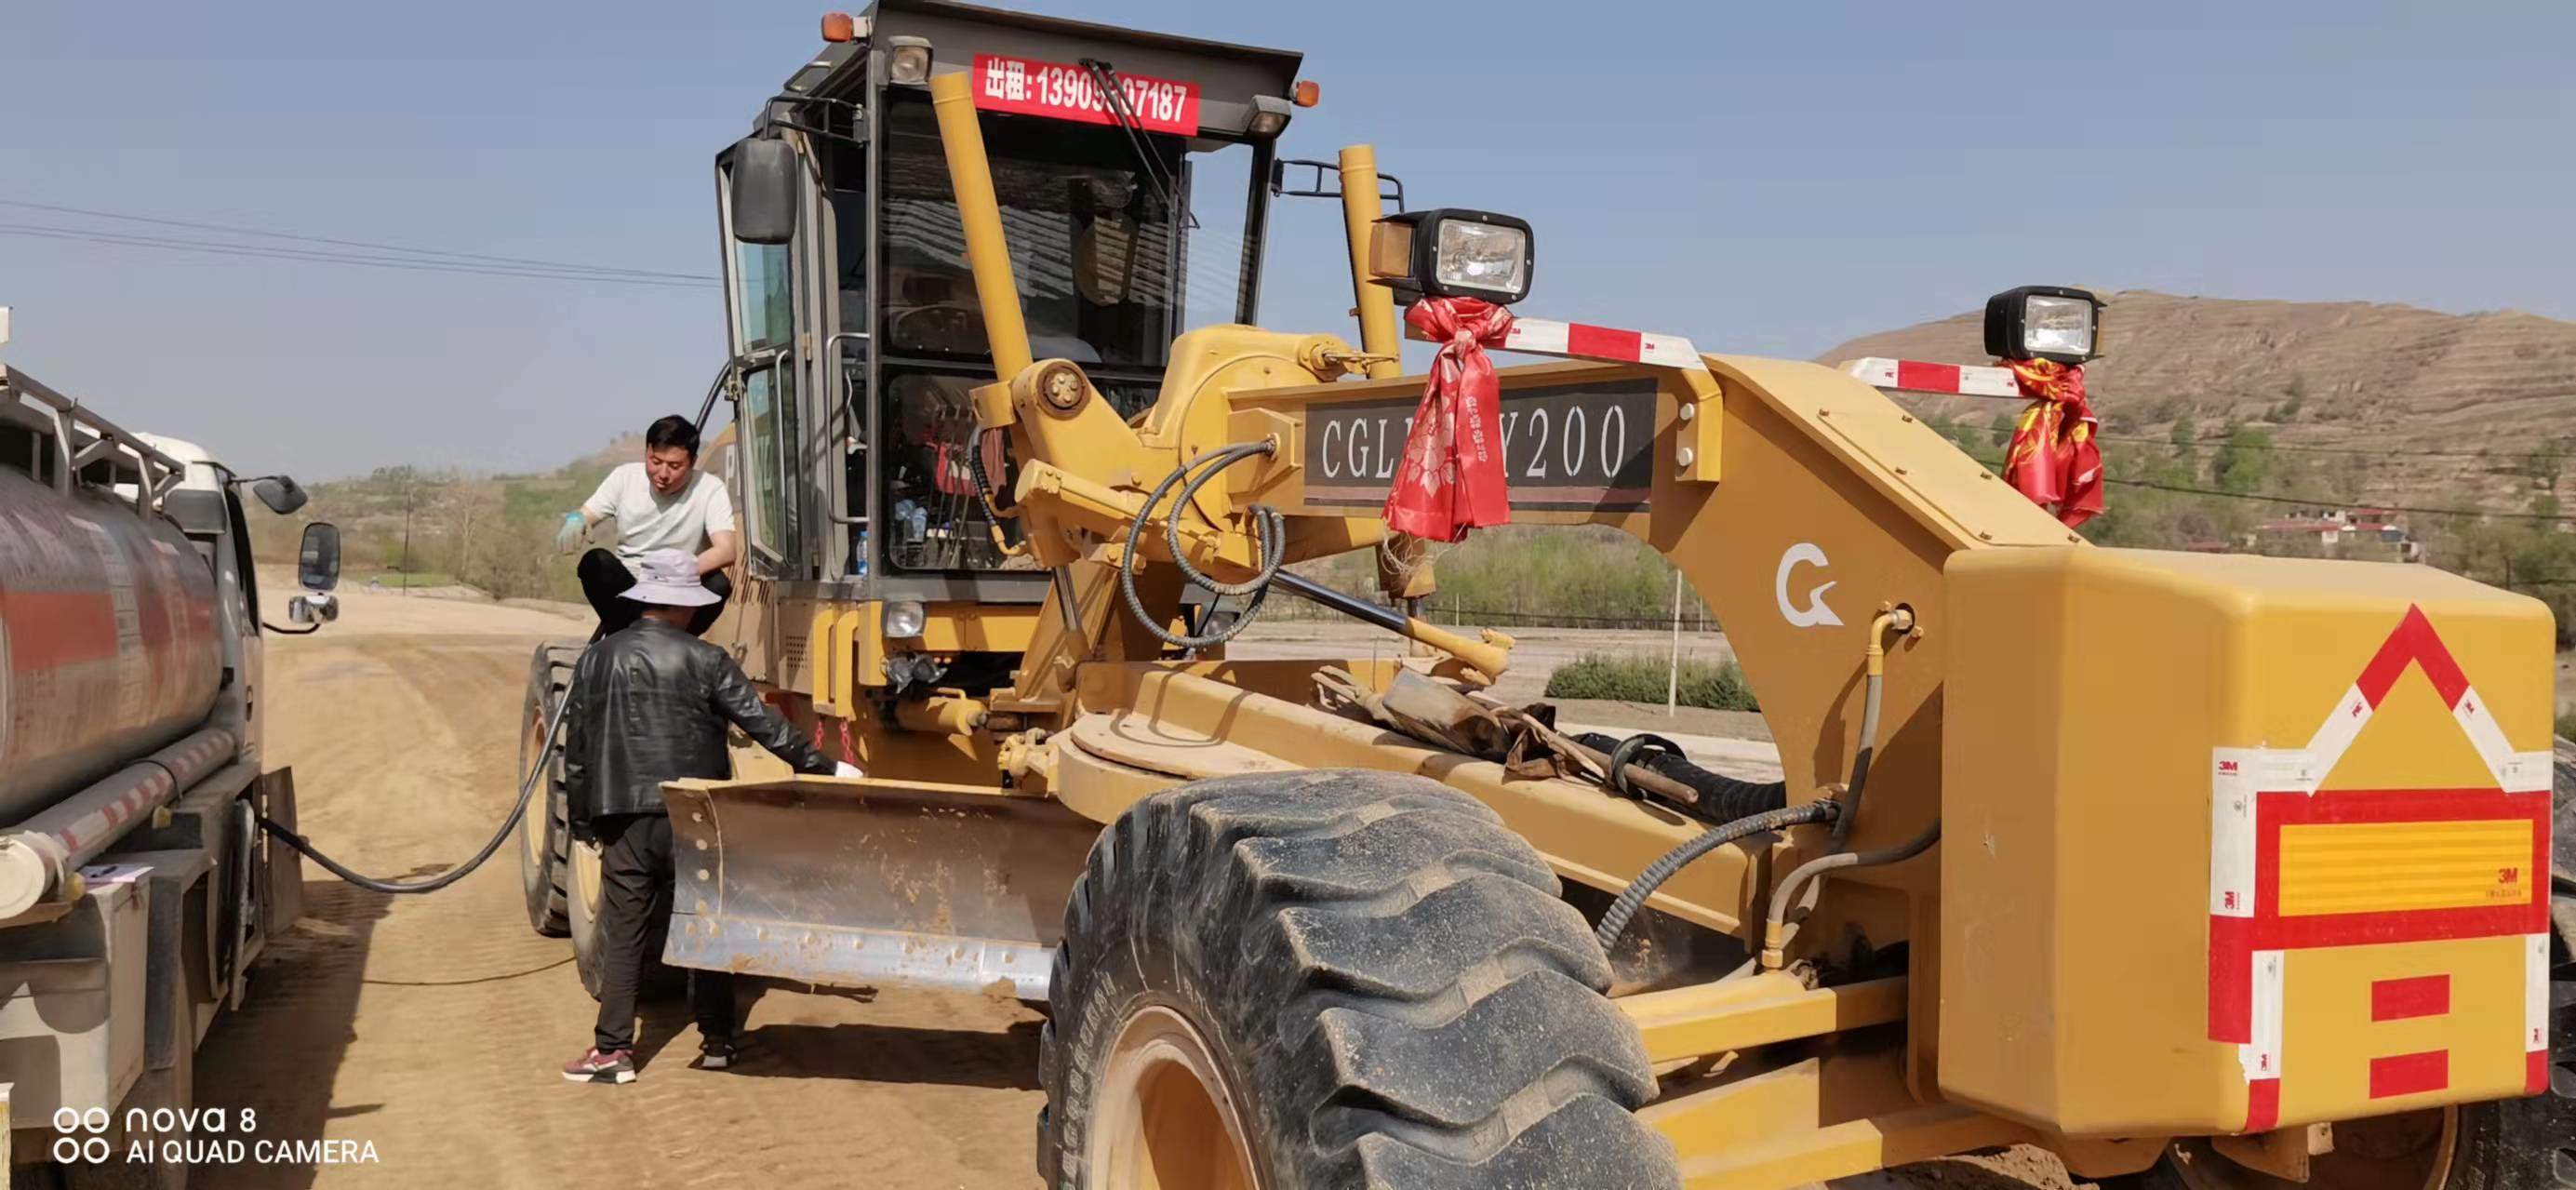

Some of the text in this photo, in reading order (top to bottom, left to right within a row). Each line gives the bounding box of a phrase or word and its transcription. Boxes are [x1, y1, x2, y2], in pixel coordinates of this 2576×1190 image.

[2219, 760, 2237, 771] 3M
[2498, 867, 2517, 884] 3M
[2224, 890, 2236, 910] 3M
